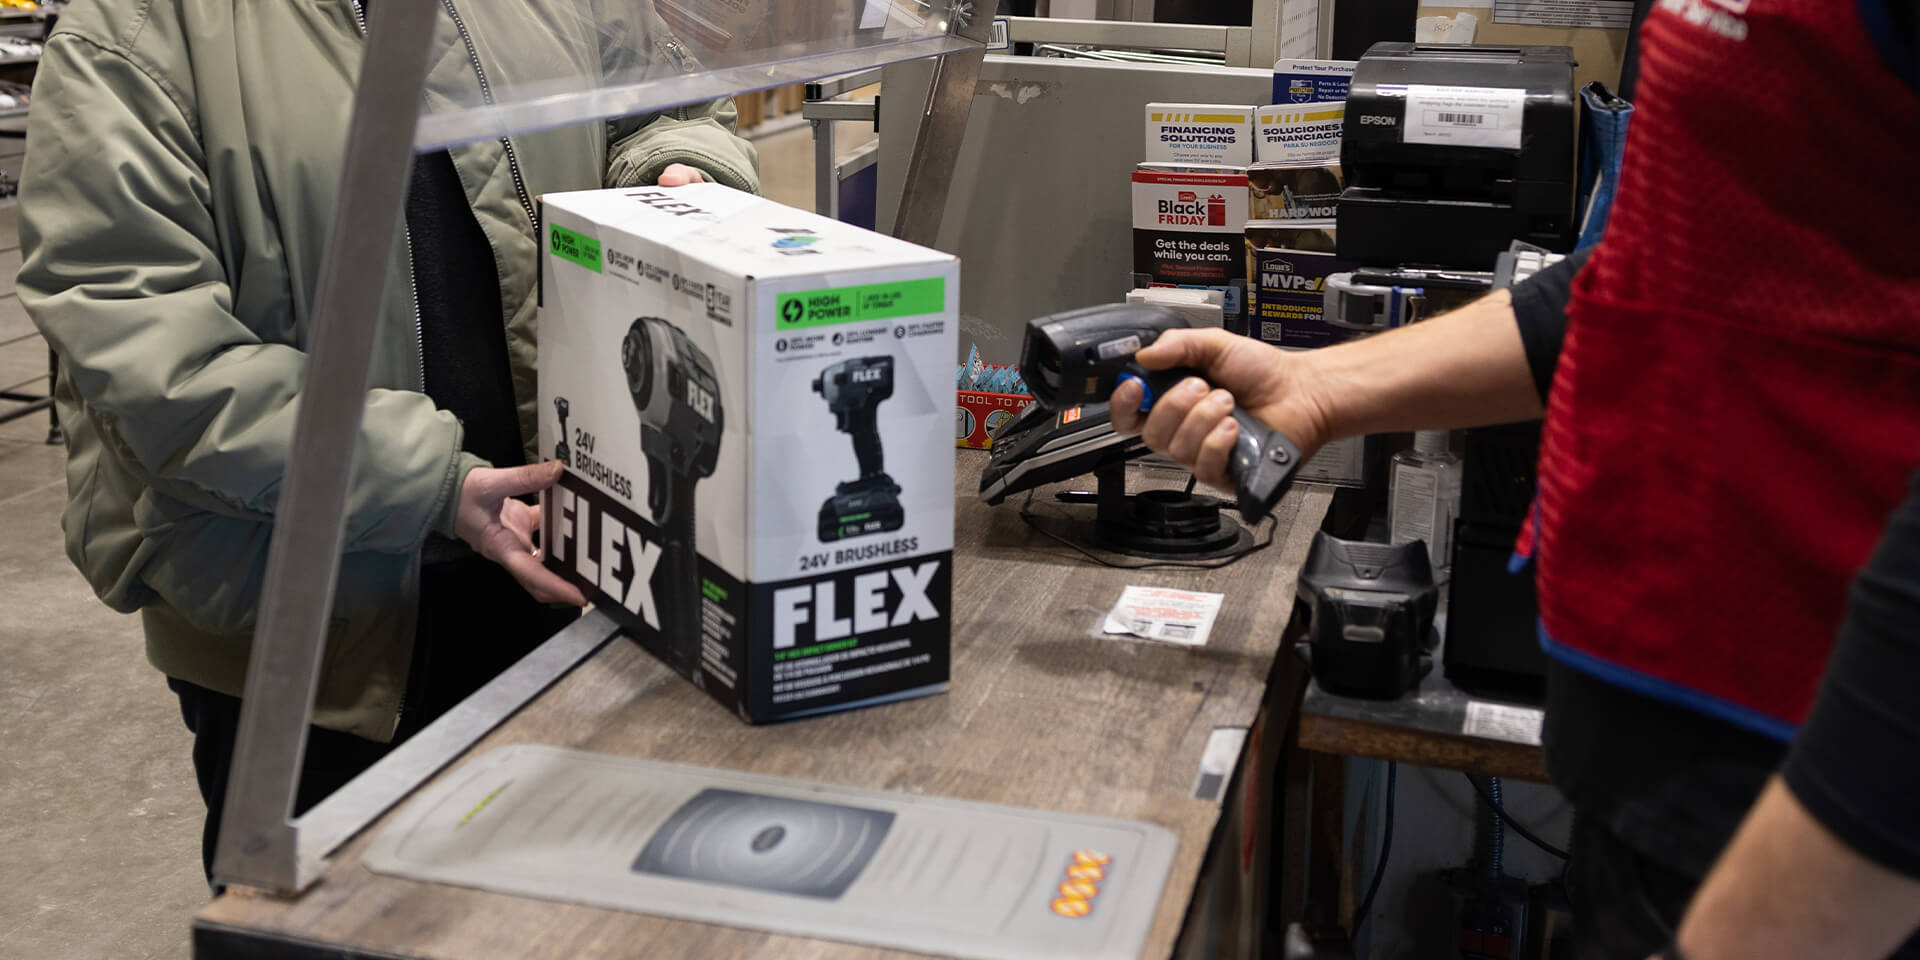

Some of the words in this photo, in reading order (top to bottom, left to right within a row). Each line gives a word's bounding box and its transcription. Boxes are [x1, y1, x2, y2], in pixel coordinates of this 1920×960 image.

[1360, 115, 1396, 126] EPSON
[1161, 125, 1236, 135] FINANCING
[1263, 123, 1339, 135] SOLUCIONES
[1160, 134, 1236, 144] SOLUTIONS
[1310, 139, 1338, 148] NEGOCIO
[624, 191, 712, 216] FLEX
[1158, 199, 1206, 215] Black
[1268, 206, 1307, 218] HARD
[1158, 214, 1206, 226] FRIDAY
[1155, 238, 1176, 249] Get
[1178, 239, 1197, 250] the
[1199, 241, 1230, 251] deals
[1154, 249, 1183, 260] while
[1184, 252, 1205, 262] you
[1207, 252, 1232, 262] can.
[1261, 272, 1315, 290] MVPs
[808, 294, 840, 308] HIGH
[808, 305, 851, 320] POWER
[1261, 303, 1323, 314] INTRODUCING
[1261, 310, 1304, 320] REWARDS
[1304, 312, 1321, 321] FOR
[853, 367, 882, 383] FLEX
[687, 379, 714, 424] FLEX
[960, 394, 993, 406] TOOL
[995, 397, 1013, 407] TO
[575, 428, 596, 455] 24V
[575, 453, 632, 500] BRUSHLESS
[552, 483, 663, 632] FLEX
[799, 552, 830, 570] 24V
[835, 536, 918, 565] BRUSHLESS
[773, 561, 941, 649] FLEX
